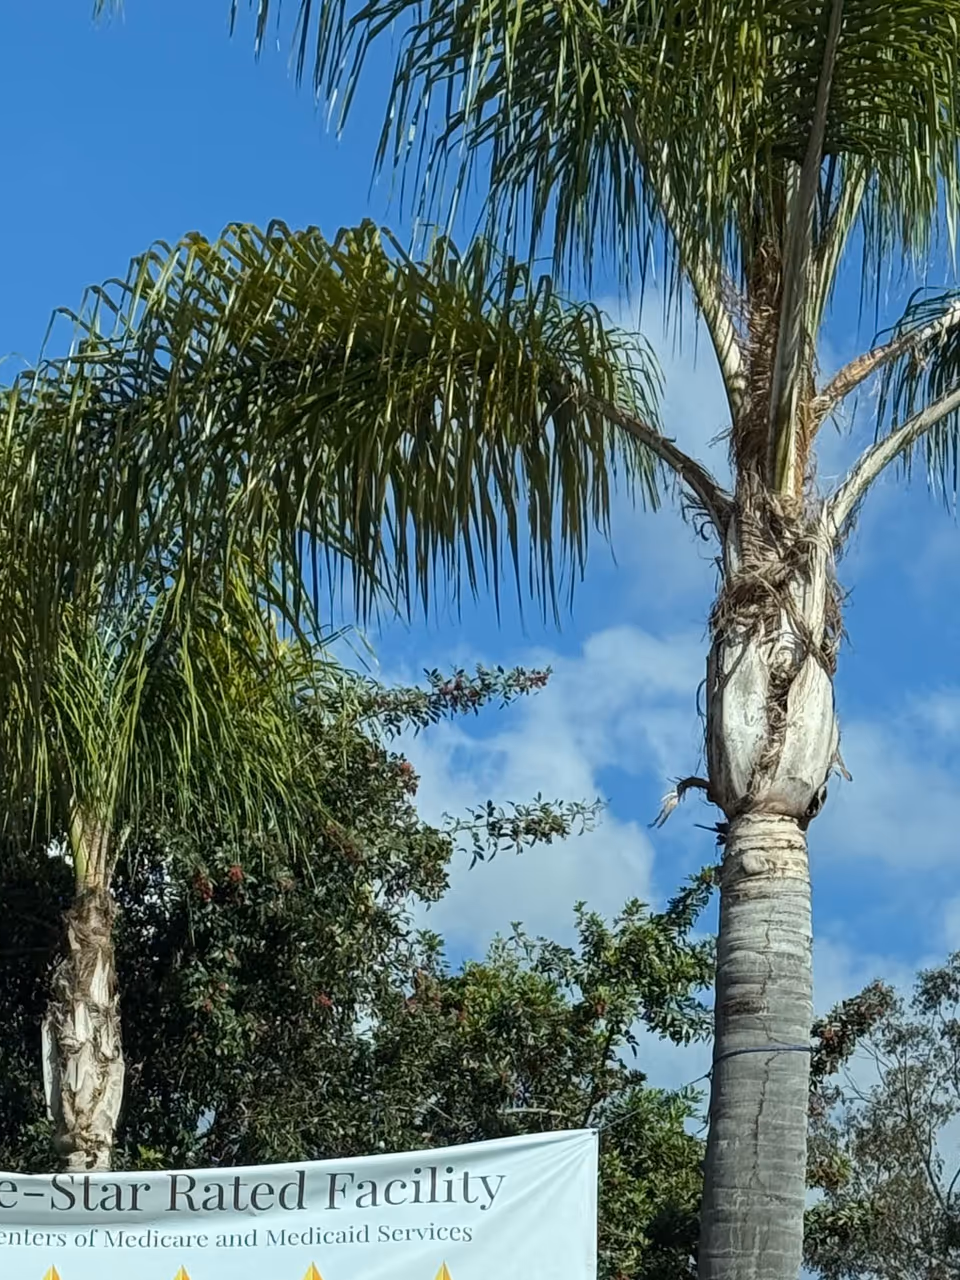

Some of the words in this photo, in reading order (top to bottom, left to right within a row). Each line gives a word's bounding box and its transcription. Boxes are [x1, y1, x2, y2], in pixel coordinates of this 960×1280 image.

[165, 1170, 307, 1212] Rated
[324, 1166, 507, 1211] Facility
[74, 1229, 98, 1247] of
[104, 1229, 208, 1248] Medicare
[216, 1229, 258, 1248] and
[265, 1224, 370, 1247] Medicaid
[377, 1222, 473, 1243] Services
